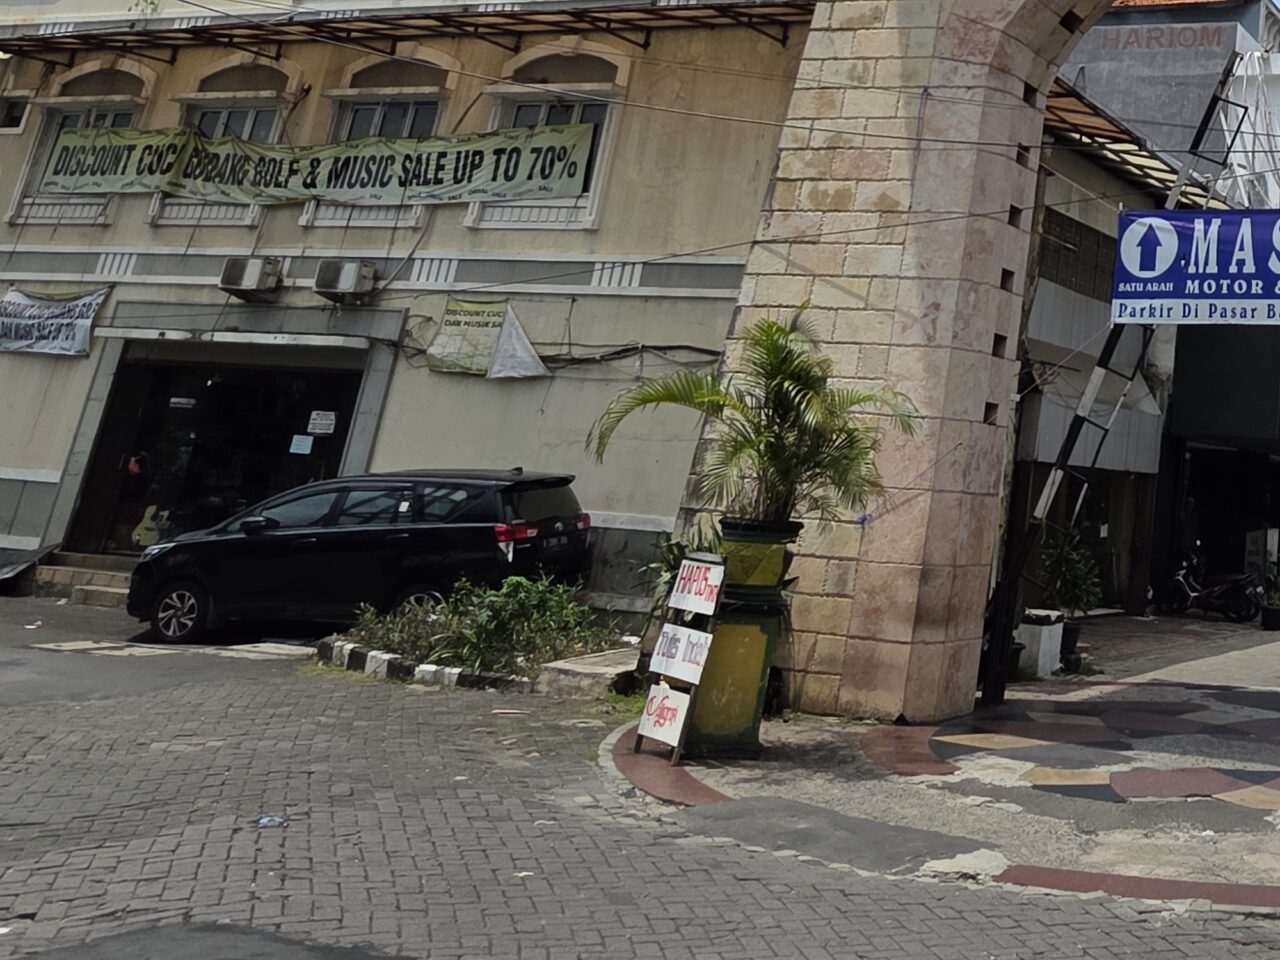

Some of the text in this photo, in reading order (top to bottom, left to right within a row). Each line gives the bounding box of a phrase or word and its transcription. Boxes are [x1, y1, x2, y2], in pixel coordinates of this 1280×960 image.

[1100, 26, 1223, 50] HARIOM
[53, 144, 138, 177] DISCOUNT
[250, 156, 300, 189] GOLF
[302, 156, 322, 189] &
[326, 154, 396, 189] MUSIC
[398, 151, 448, 188] SALE
[453, 149, 485, 184] UP
[491, 146, 522, 182] TO
[527, 143, 578, 180] 70%
[1118, 282, 1173, 292] SATU ARAH
[1184, 279, 1264, 294] MOTOR
[446, 309, 485, 318] DISCOUNT
[1117, 303, 1174, 319] Parkir
[1182, 303, 1199, 319] Di
[1208, 303, 1258, 319] Pasar
[463, 320, 490, 328] MUSIK
